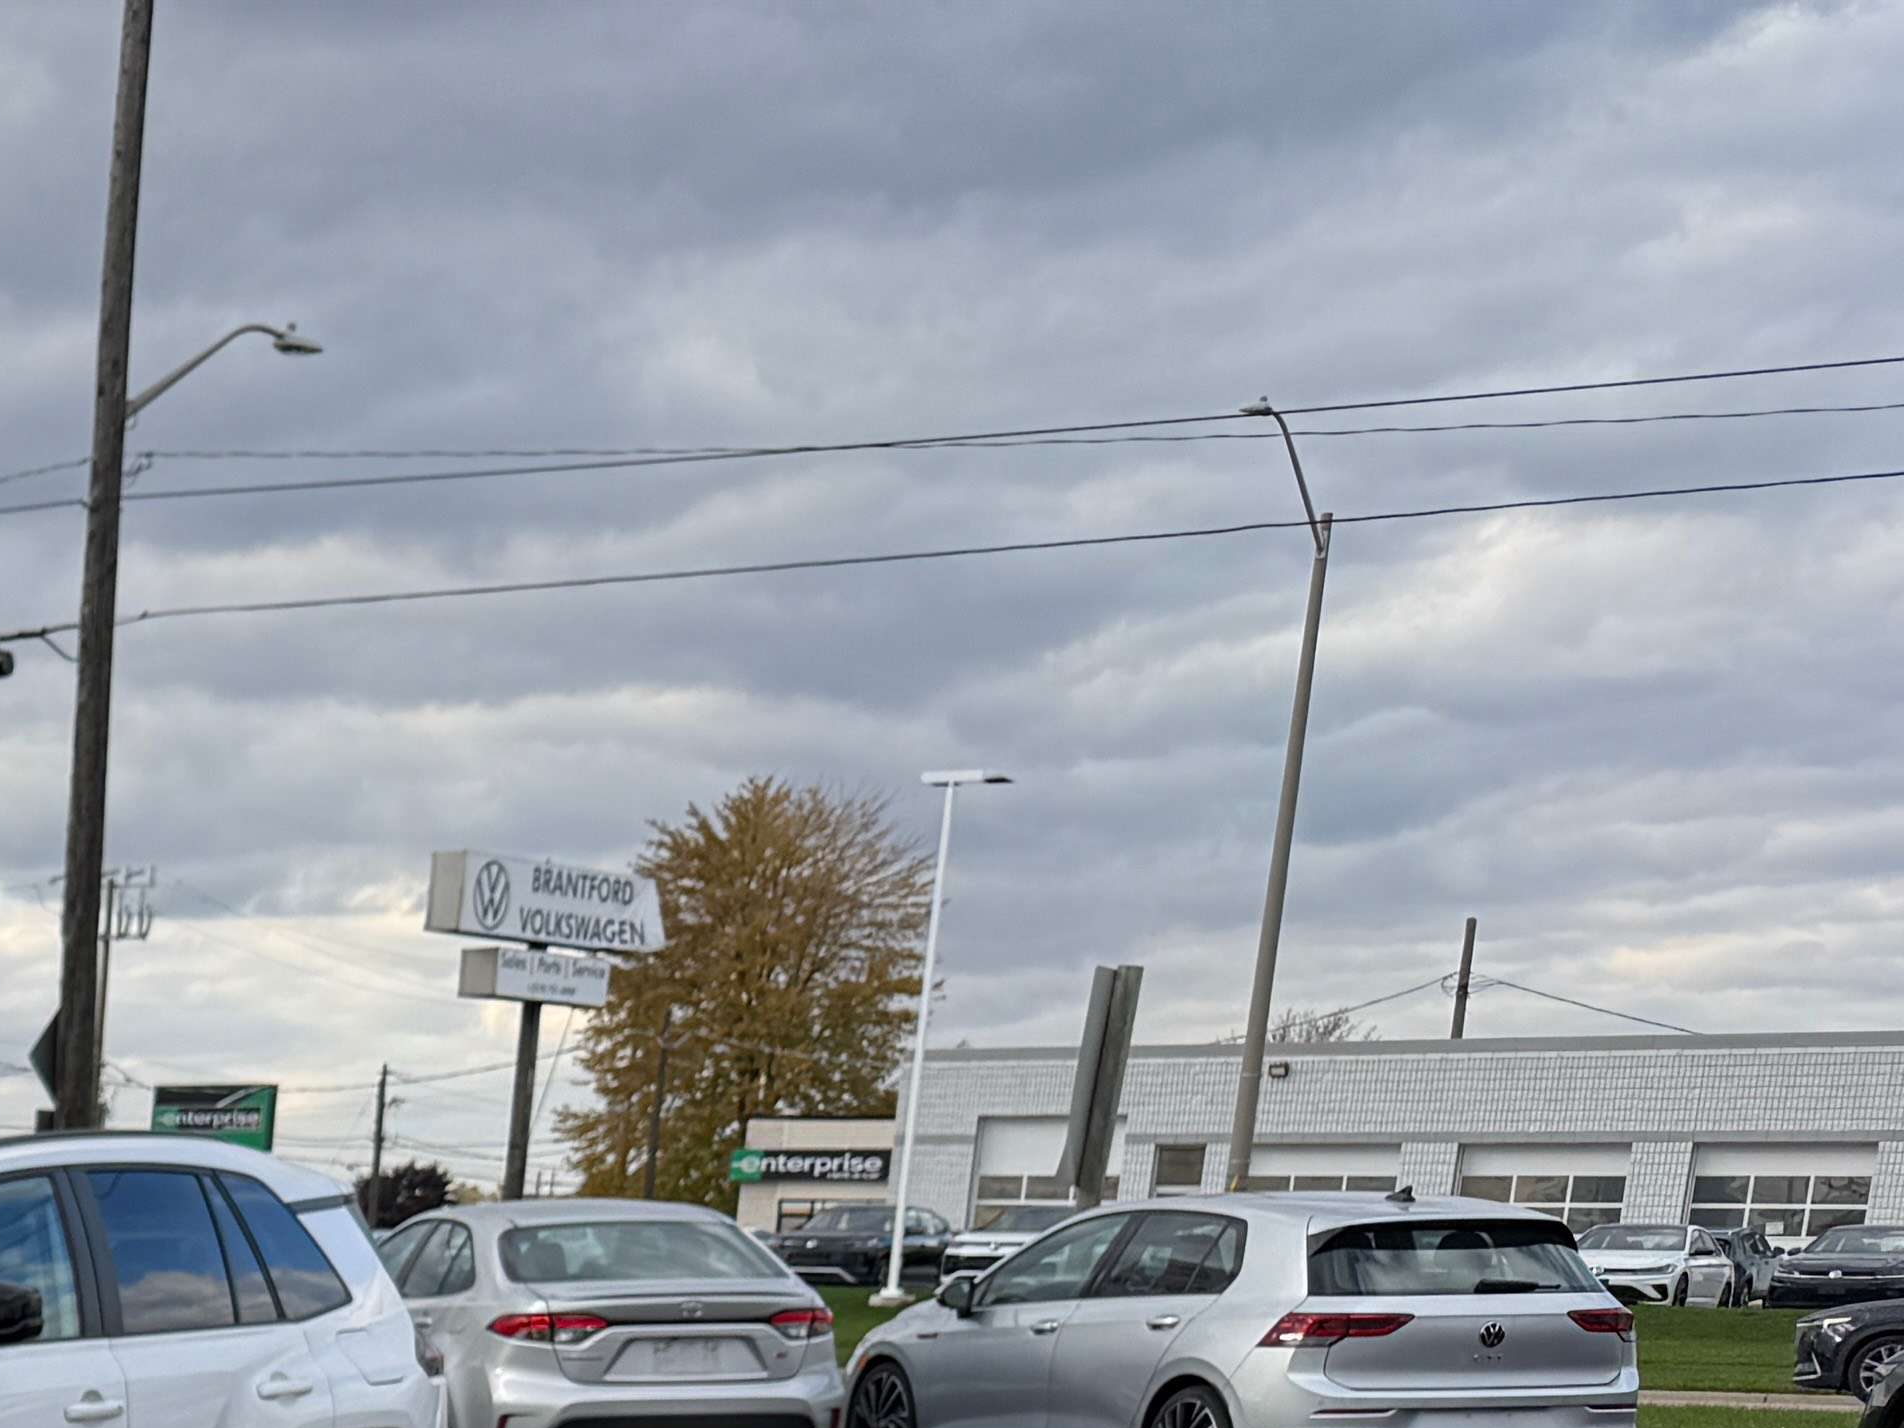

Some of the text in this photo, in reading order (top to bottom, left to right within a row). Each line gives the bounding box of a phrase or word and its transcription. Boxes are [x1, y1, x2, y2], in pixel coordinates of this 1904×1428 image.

[531, 866, 634, 906] BRANTFORD
[520, 906, 645, 946] VOLKSWAGEN
[160, 1110, 260, 1129] enterprise
[734, 1152, 883, 1177] enterprise
